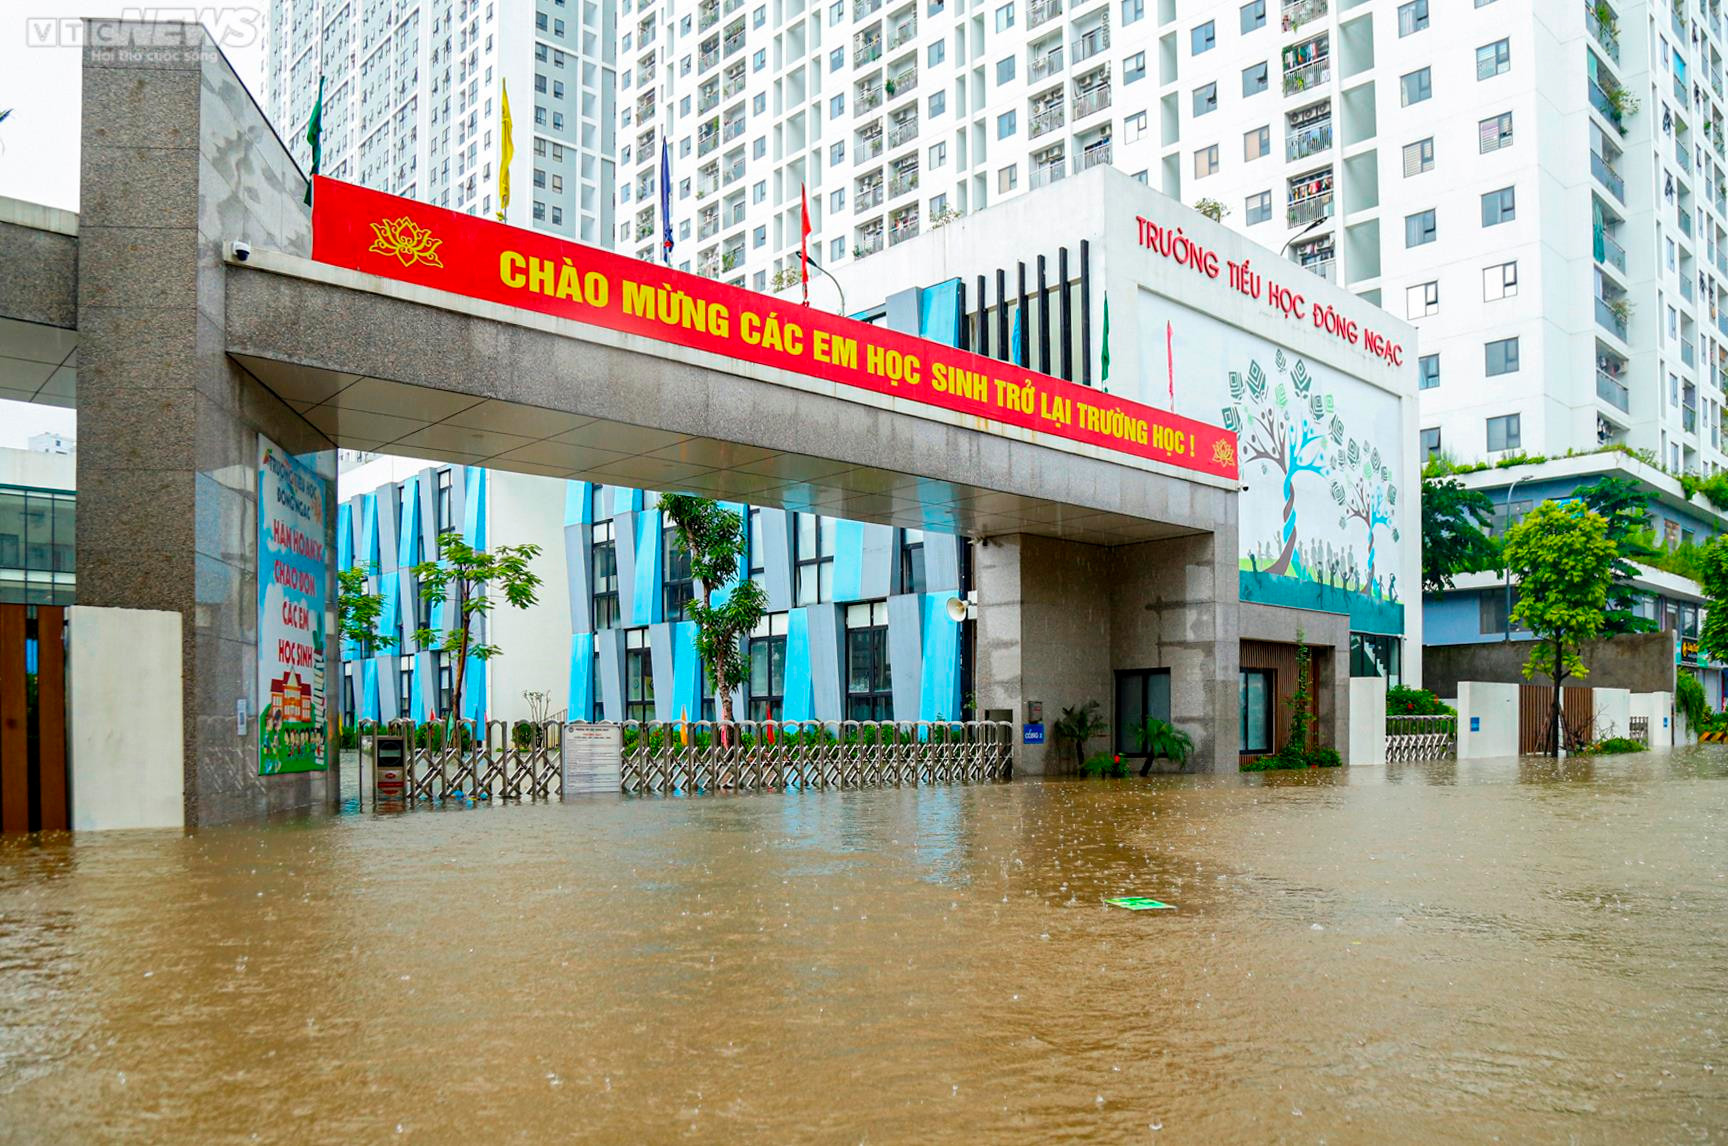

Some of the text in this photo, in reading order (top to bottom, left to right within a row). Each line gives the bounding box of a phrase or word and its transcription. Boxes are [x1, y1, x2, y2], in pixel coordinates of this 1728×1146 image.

[499, 250, 609, 309] CHÀO
[622, 280, 730, 339] MỪNG
[740, 312, 804, 356] CÁC
[813, 329, 858, 370] EM
[867, 344, 921, 387] HỌC
[931, 362, 988, 403] SINH
[994, 378, 1036, 415] TRỞ
[1040, 391, 1072, 428] LẠI
[1077, 401, 1149, 445] TRƯỜNG
[1152, 424, 1185, 457] HỌC
[1136, 215, 1404, 367] TRƯỜNG TIỂU HỌC ĐÔNG NGẠC
